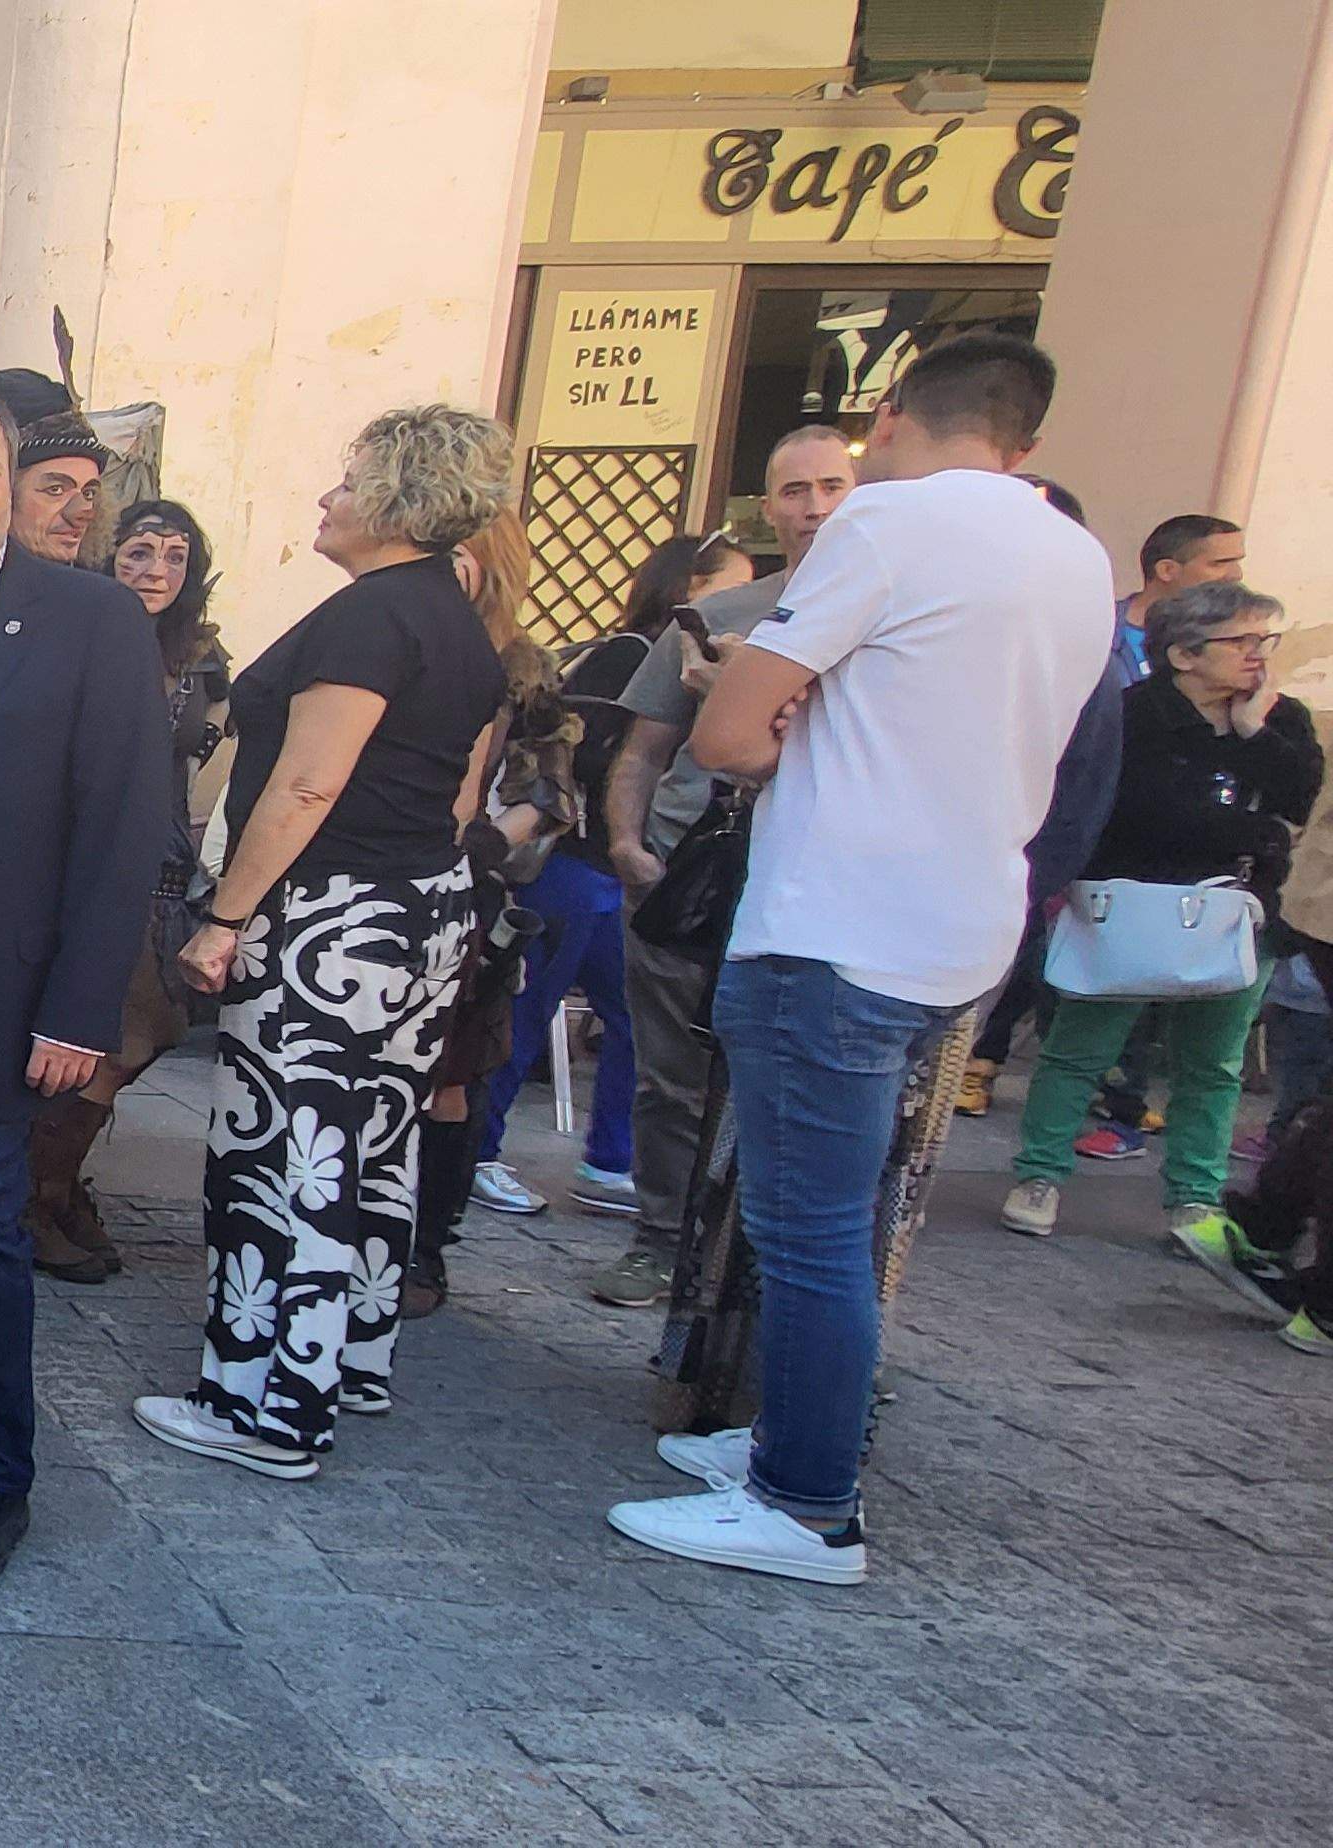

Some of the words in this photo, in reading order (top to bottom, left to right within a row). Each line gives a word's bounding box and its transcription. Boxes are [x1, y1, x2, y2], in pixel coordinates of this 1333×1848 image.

[701, 117, 965, 243] Café
[569, 299, 699, 332] LLÁMAME
[575, 346, 642, 368] PERO
[568, 380, 610, 406] SIN
[619, 376, 659, 406] LL
